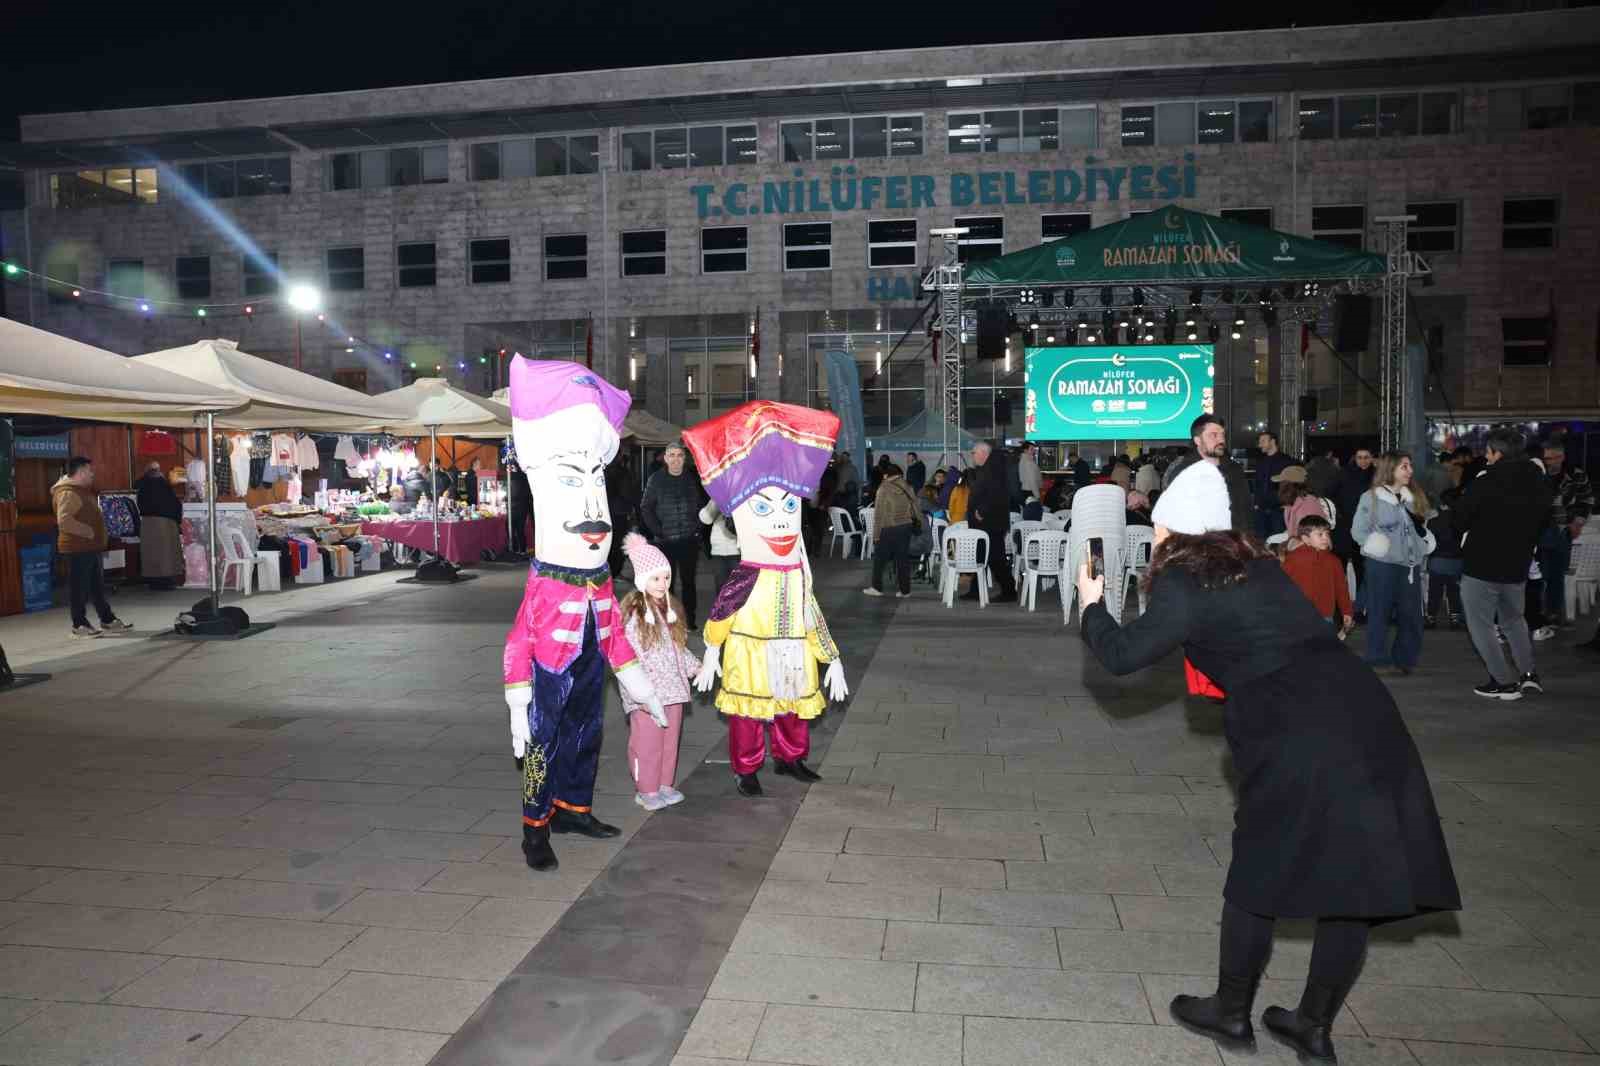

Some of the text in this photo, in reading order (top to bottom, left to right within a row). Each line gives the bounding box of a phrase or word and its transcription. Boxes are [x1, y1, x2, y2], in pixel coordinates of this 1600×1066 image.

[950, 152, 1197, 206] BELEDİYESİ
[1103, 246, 1177, 268] RAMAZAN
[1058, 376, 1180, 396] RAMAZAN SOKAĞI
